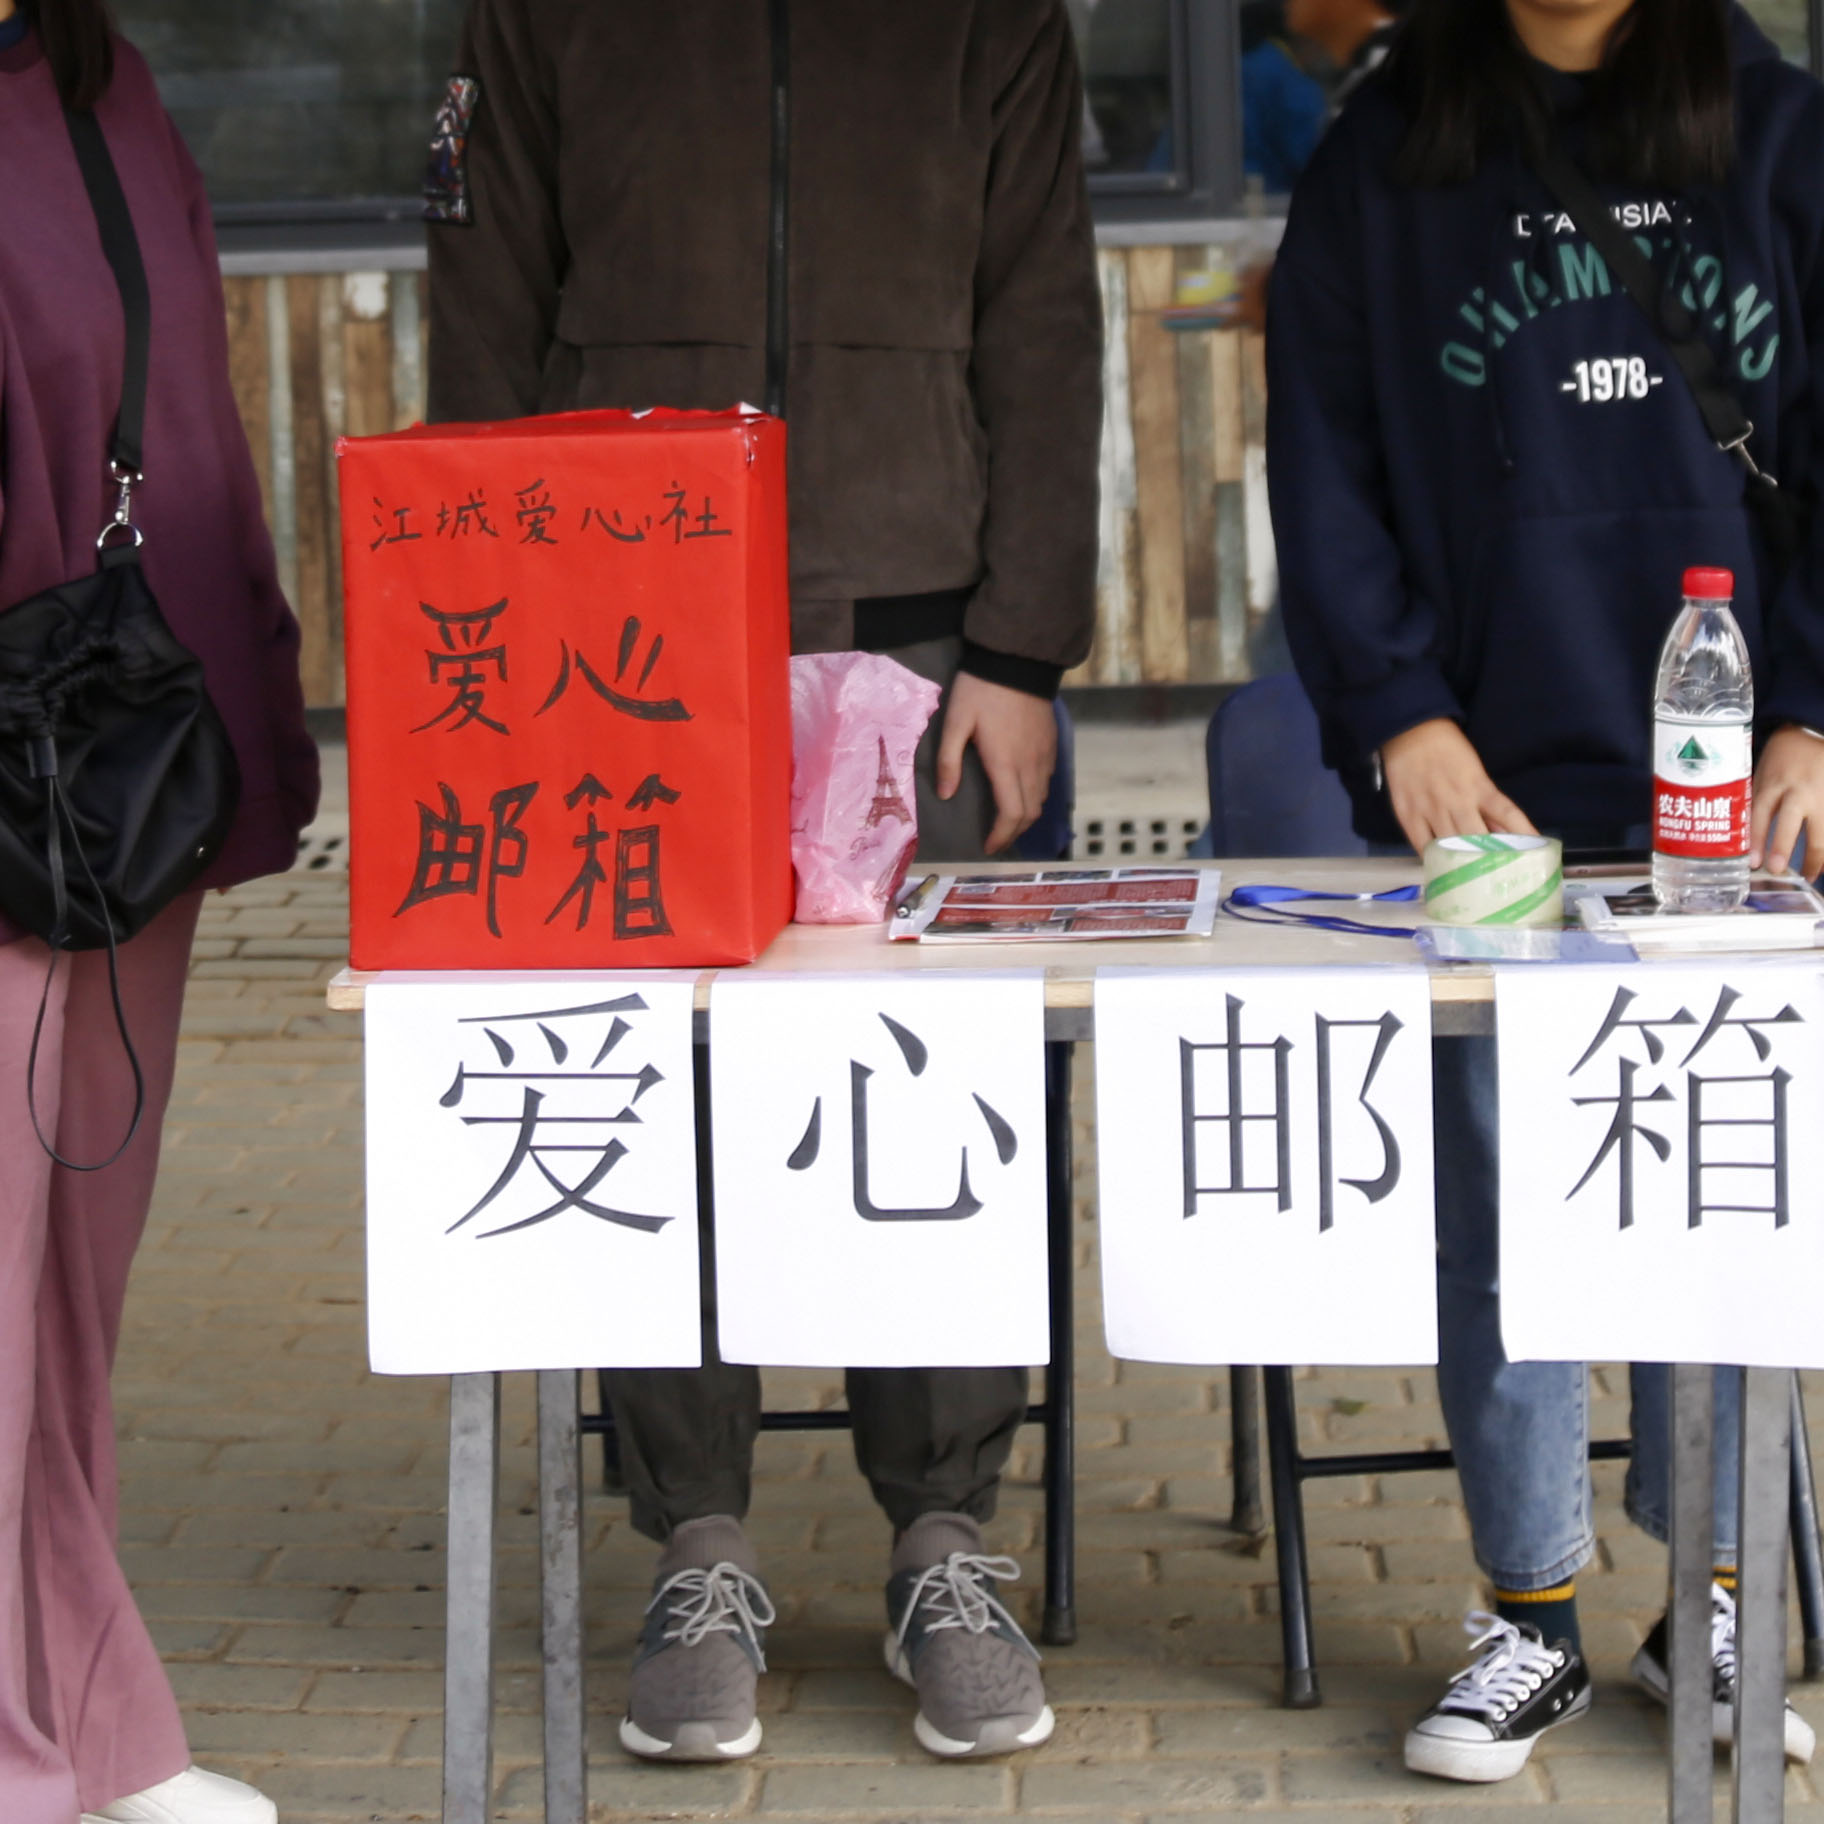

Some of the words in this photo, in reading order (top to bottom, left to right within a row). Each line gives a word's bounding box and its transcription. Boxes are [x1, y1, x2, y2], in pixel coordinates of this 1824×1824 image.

[370, 478, 733, 551] 江城爱心社
[410, 596, 695, 736] 爱心
[1659, 793, 1732, 819] 农夫山泉
[1695, 819, 1732, 831] SPRING
[392, 772, 683, 942] 邮箱
